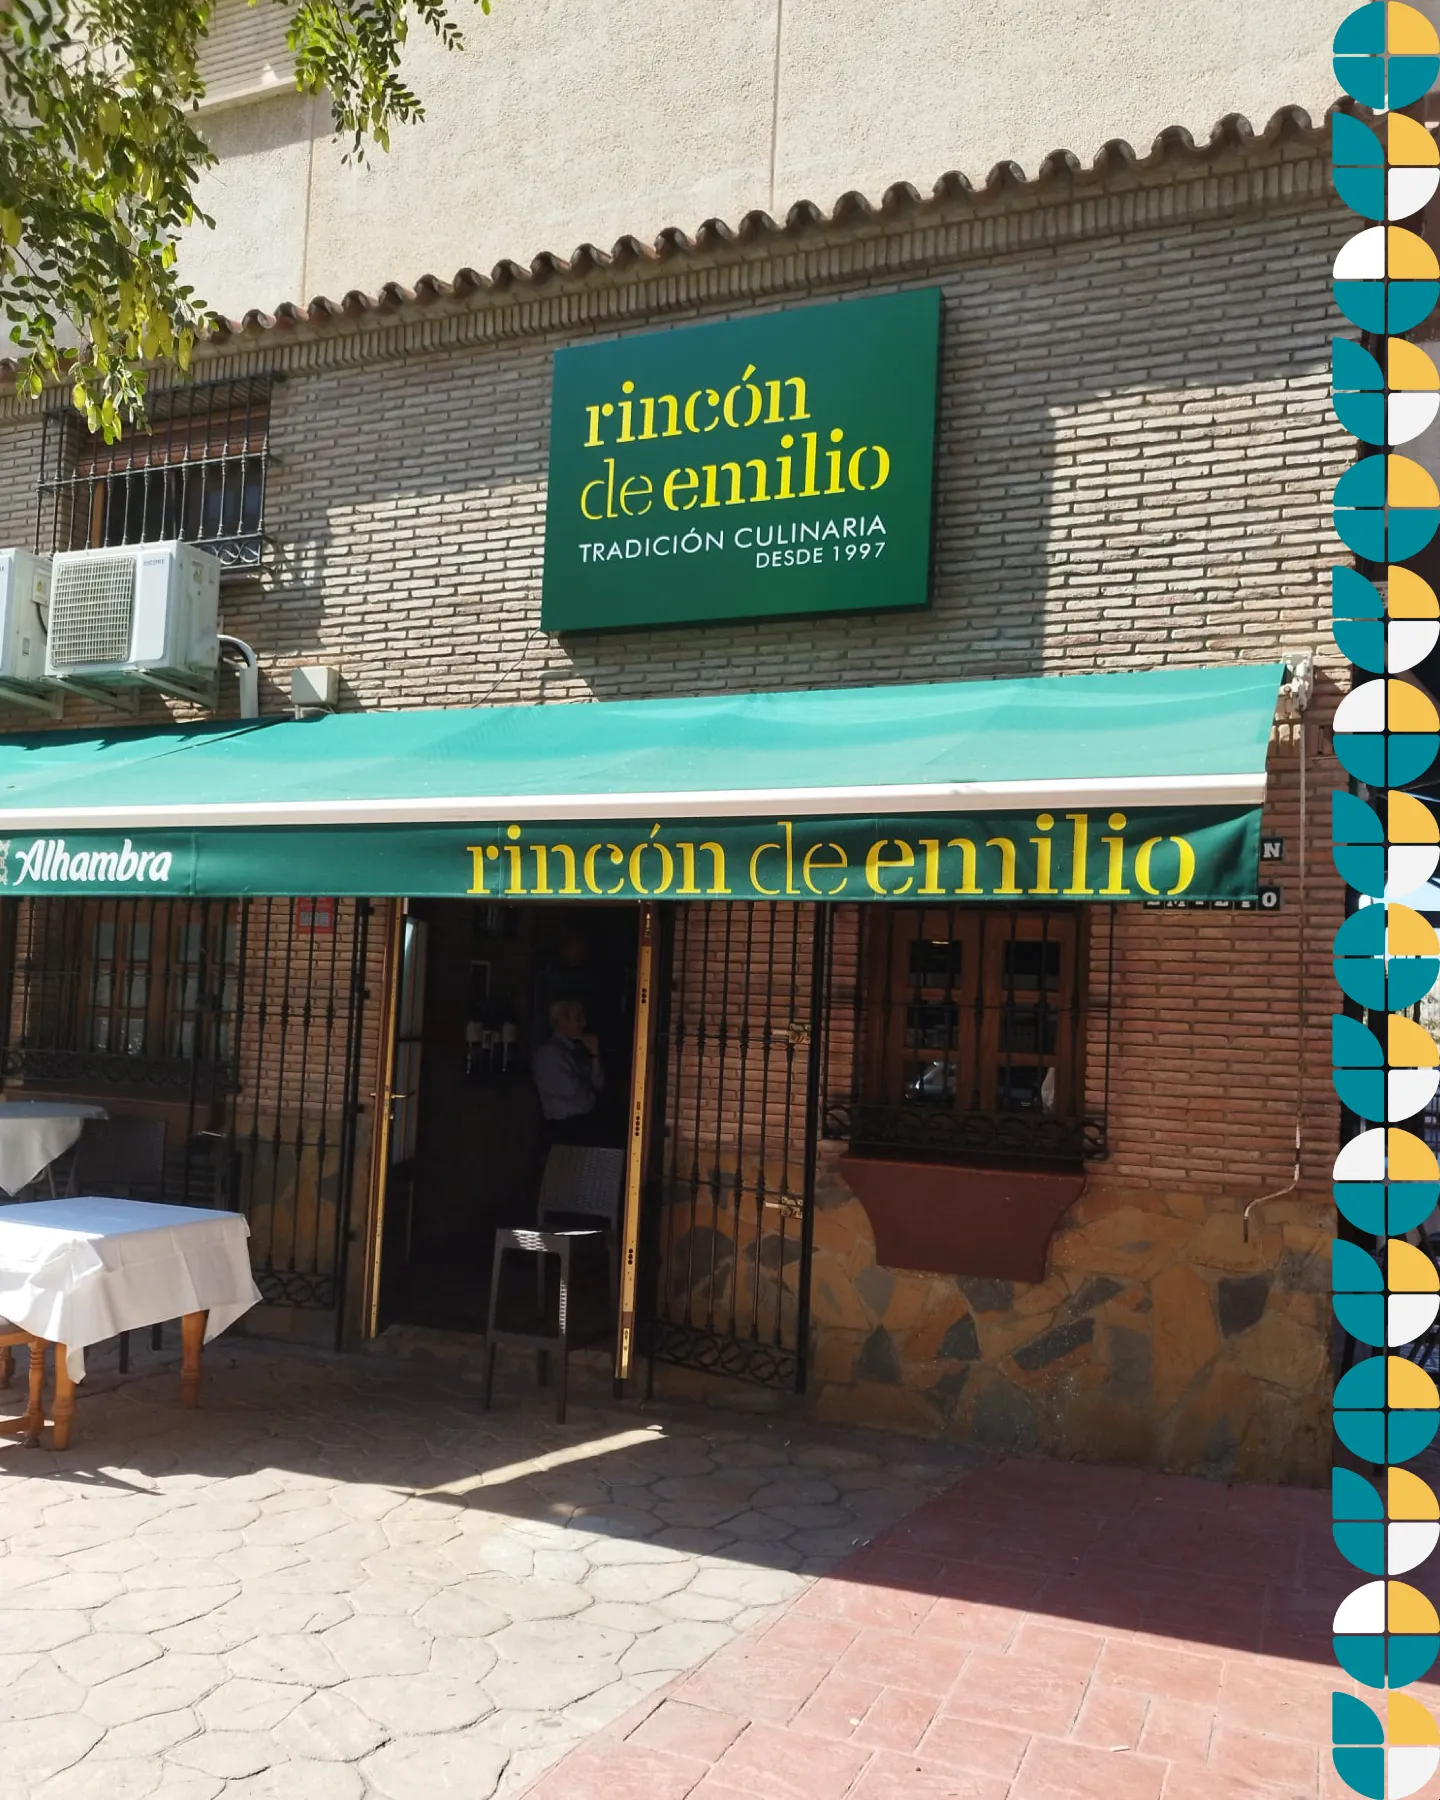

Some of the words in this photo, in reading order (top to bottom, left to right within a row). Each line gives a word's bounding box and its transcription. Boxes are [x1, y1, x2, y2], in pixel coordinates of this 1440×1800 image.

[583, 363, 811, 448] rincón
[580, 457, 654, 521] de
[662, 428, 891, 512] emilio
[578, 526, 725, 564] TRADICIÓN
[734, 514, 888, 548] CULINARIA
[755, 546, 824, 569] DESDE
[832, 541, 887, 563] 1997
[12, 838, 174, 887] Alhambra
[466, 822, 732, 895] rincón
[749, 821, 849, 895] de
[865, 812, 1197, 896] emilio
